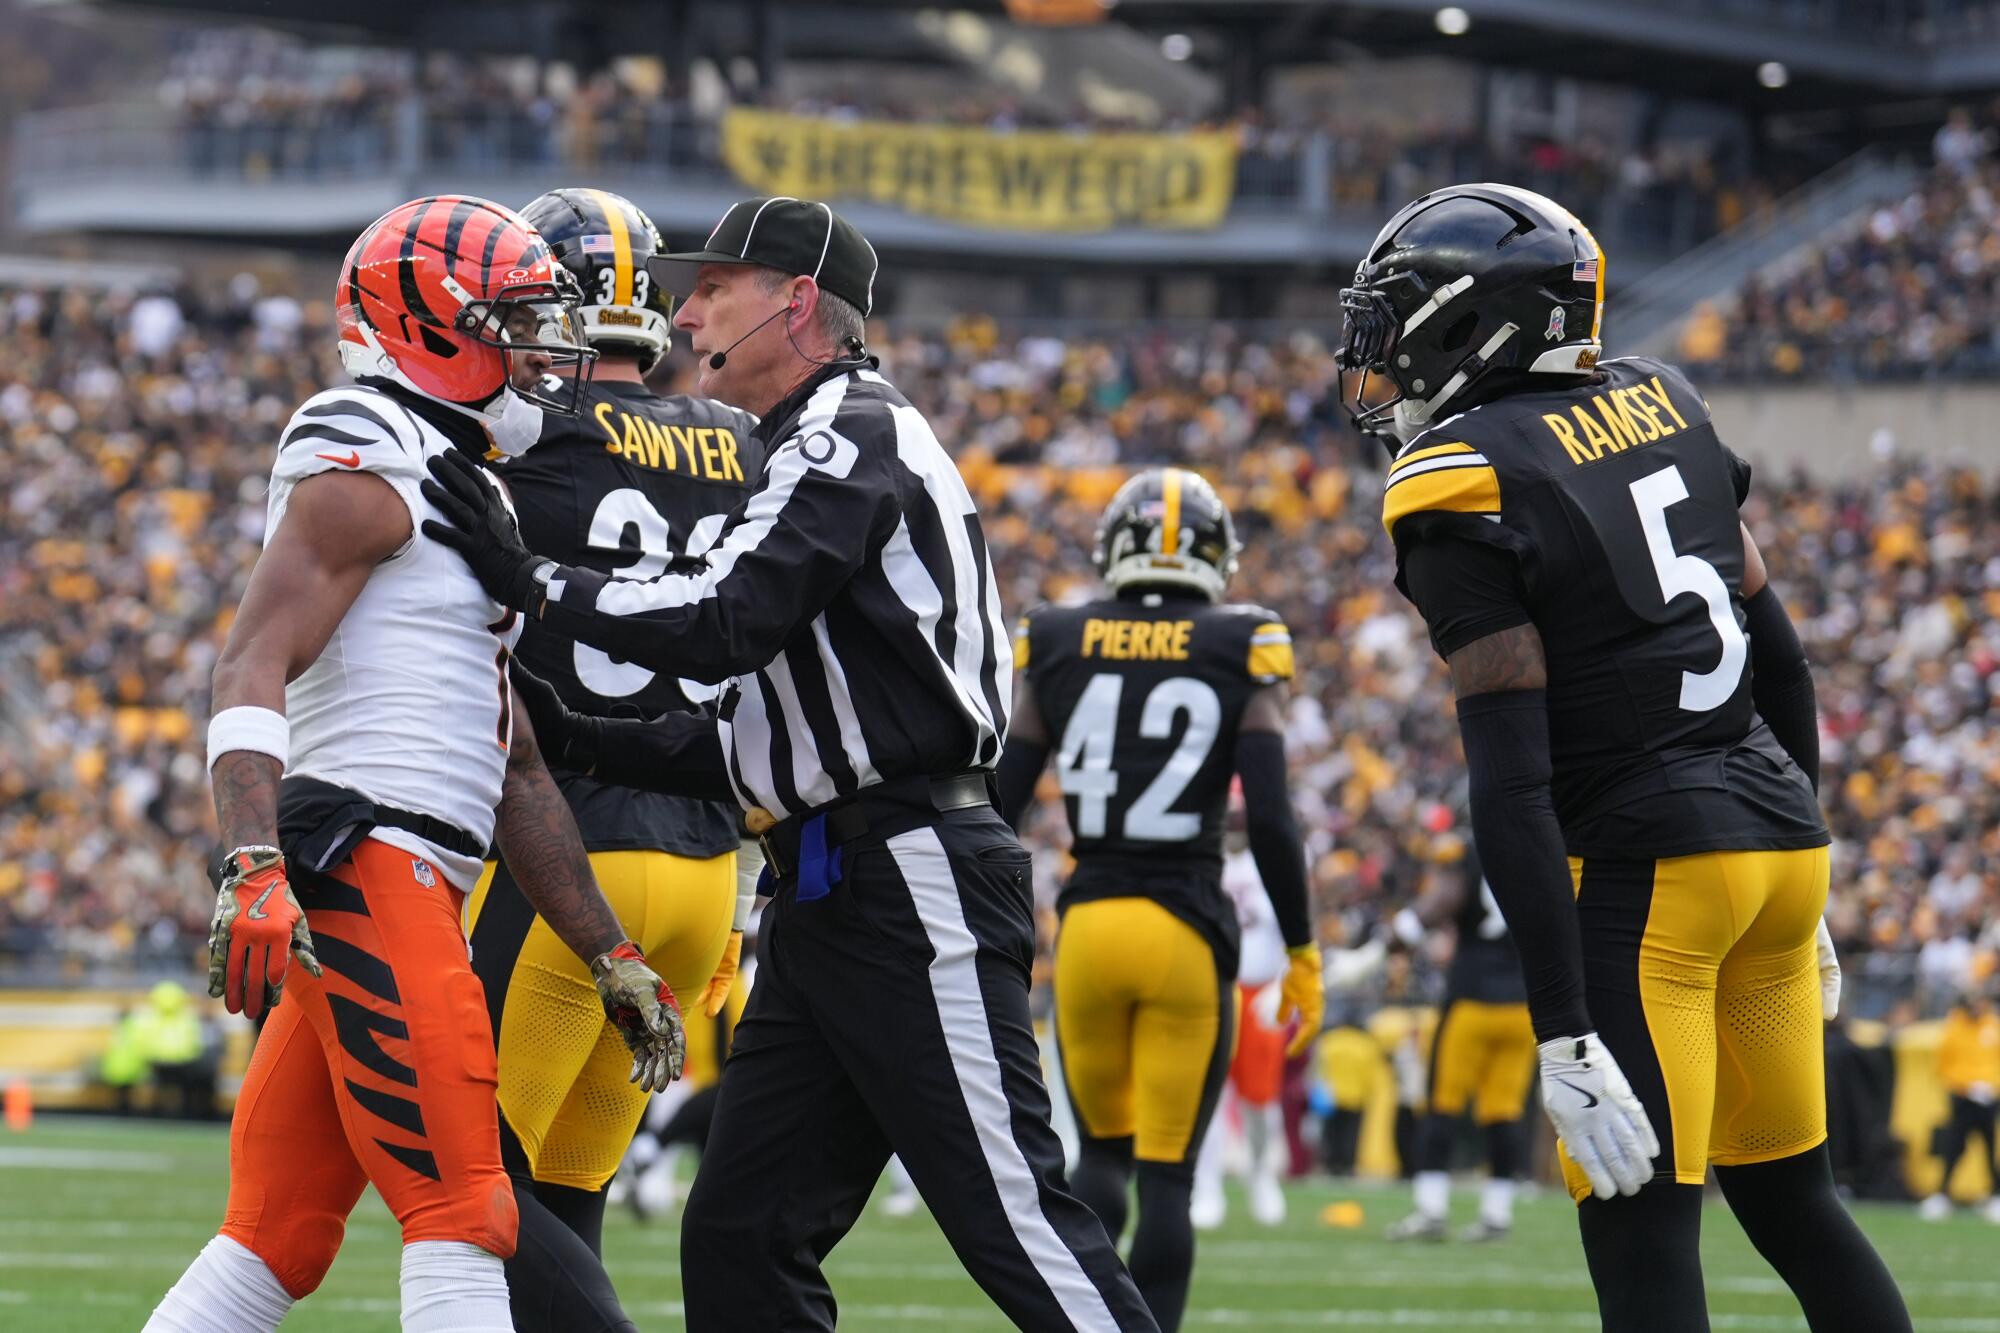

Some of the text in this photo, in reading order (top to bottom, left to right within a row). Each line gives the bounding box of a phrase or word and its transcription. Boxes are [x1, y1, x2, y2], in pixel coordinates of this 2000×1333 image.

[594, 402, 744, 482] SAWYER
[1541, 376, 1689, 465] RAMSEY
[1628, 464, 1748, 712] 5
[1081, 618, 1194, 661] PIERRE
[1056, 673, 1222, 842] 42
